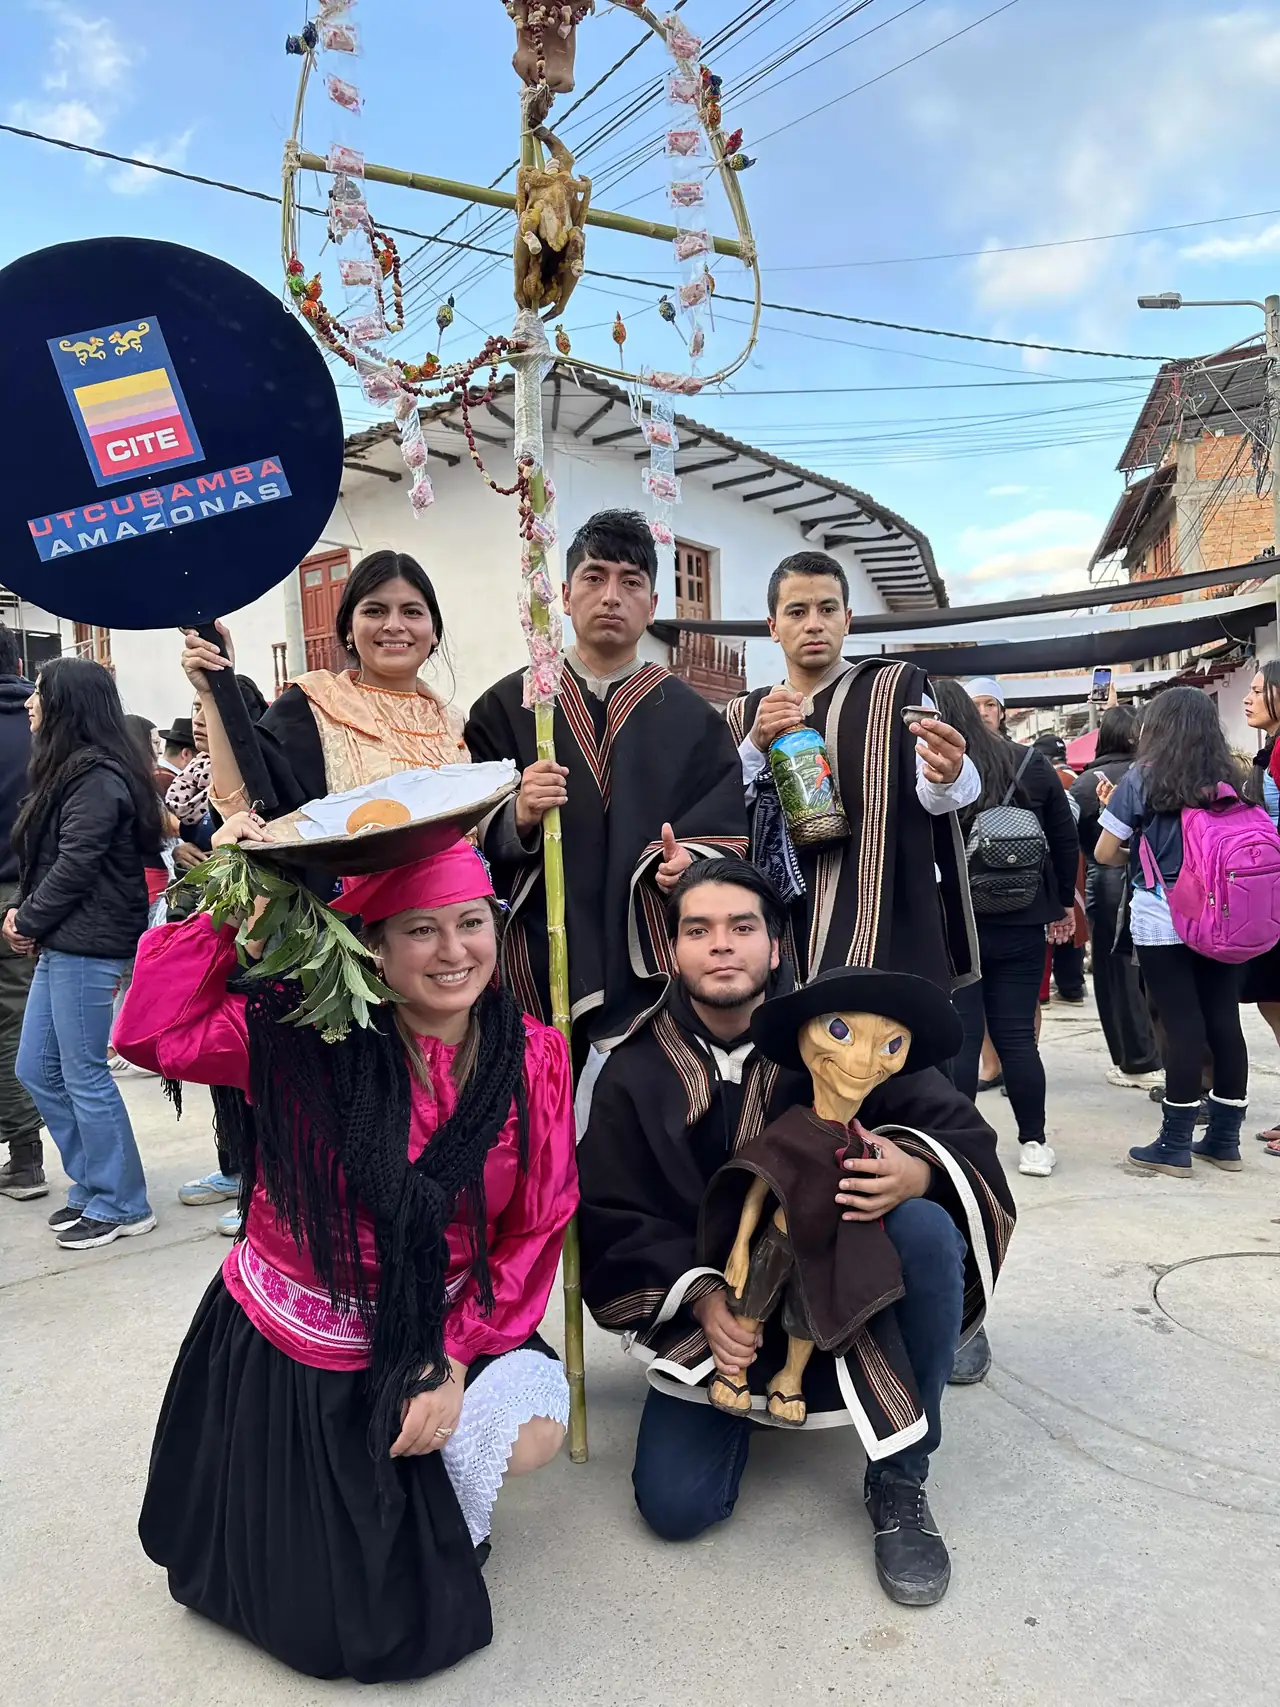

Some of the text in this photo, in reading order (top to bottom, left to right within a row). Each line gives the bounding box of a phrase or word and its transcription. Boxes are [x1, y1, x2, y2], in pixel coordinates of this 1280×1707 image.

[106, 427, 179, 462] CITE
[28, 459, 282, 537] UTCUBAMBA
[51, 482, 281, 558] AMAZONAS
